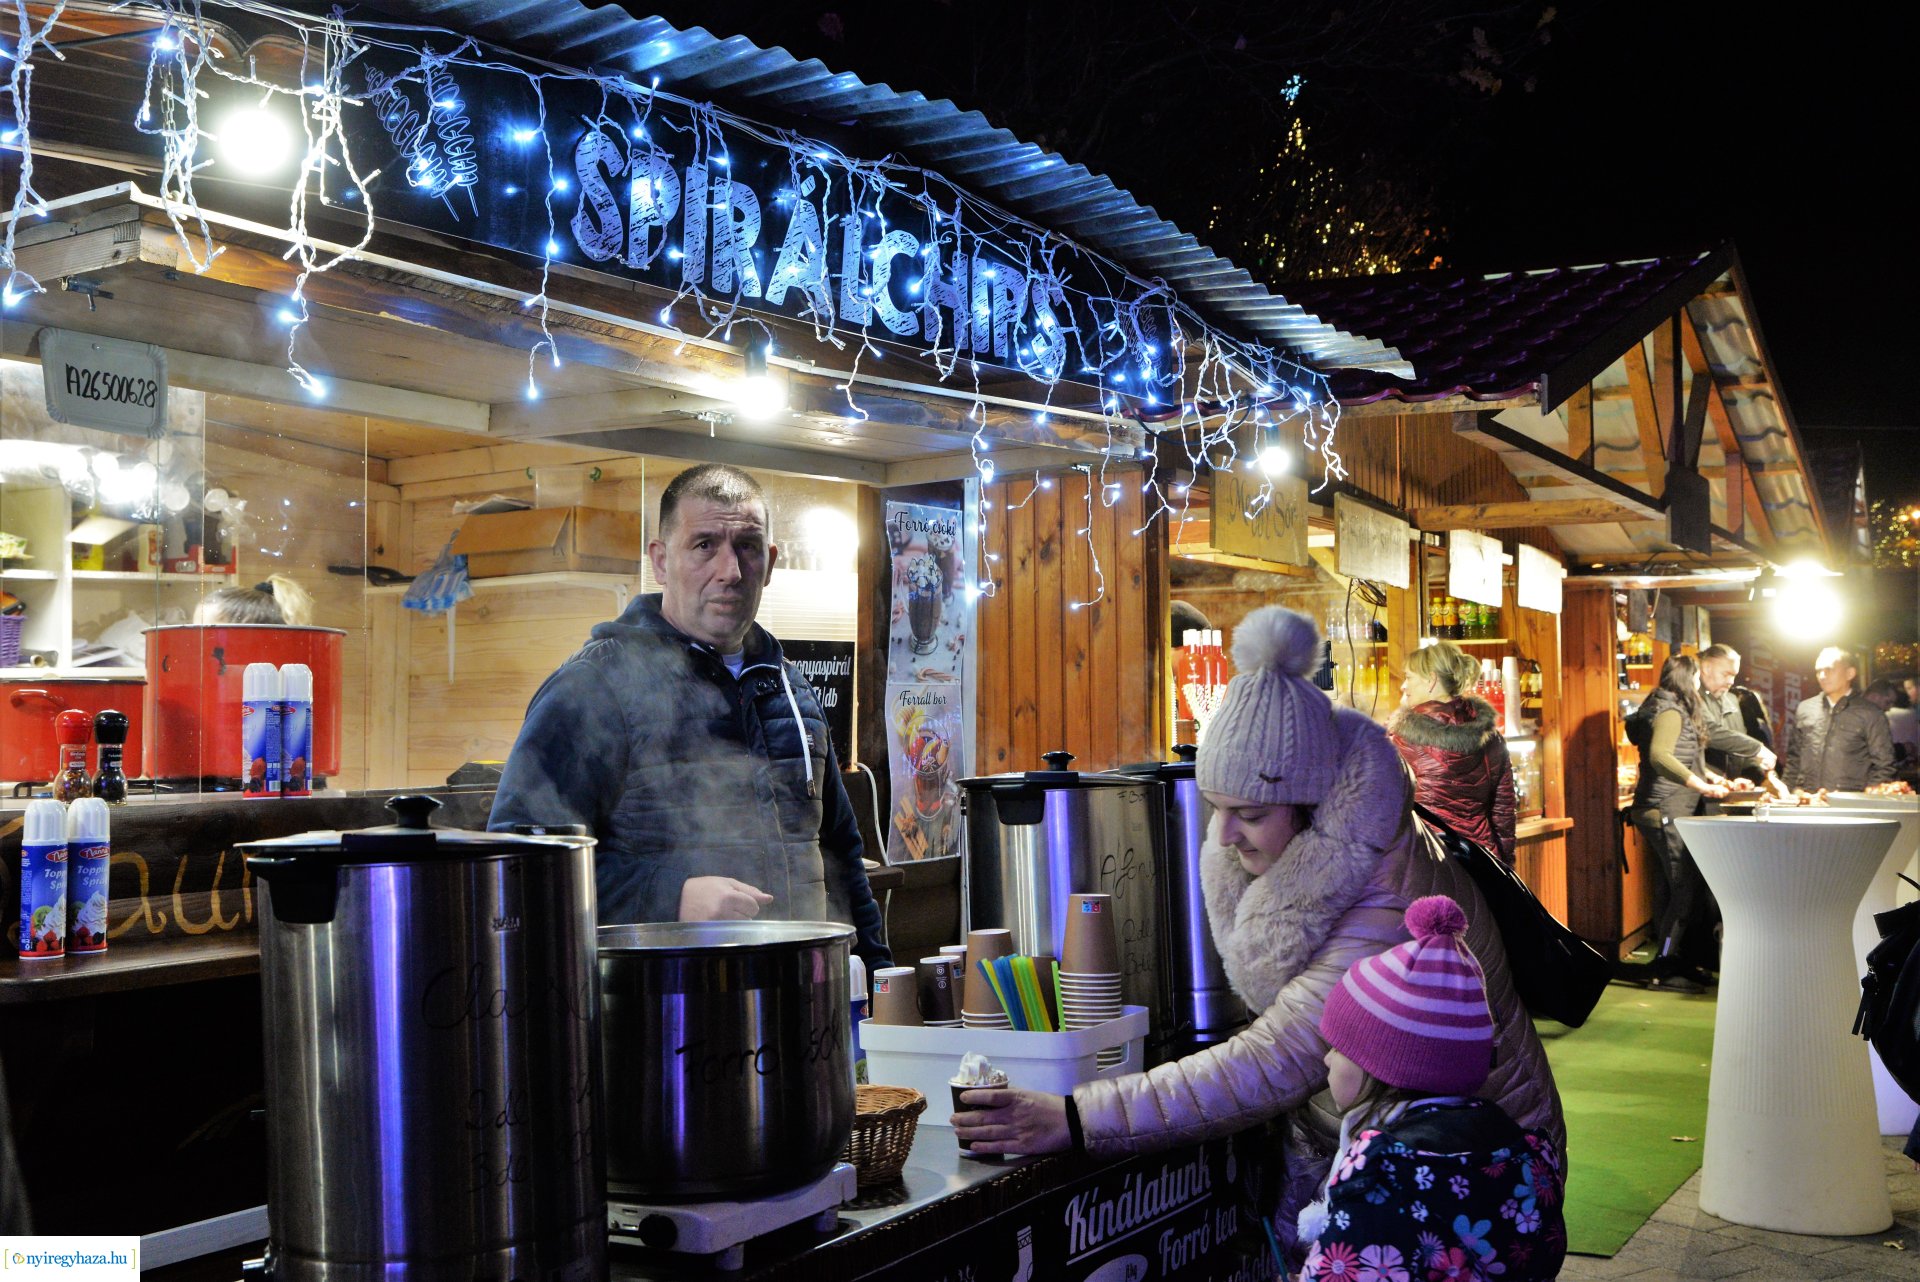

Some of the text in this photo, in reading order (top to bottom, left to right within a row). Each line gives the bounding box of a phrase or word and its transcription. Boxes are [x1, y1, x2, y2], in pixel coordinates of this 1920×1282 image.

[65, 363, 158, 408] A26500628
[894, 511, 930, 532] Forró
[932, 691, 948, 705] bor
[1064, 1143, 1213, 1256] Kínálatunk
[1158, 1203, 1238, 1278] Forró tea
